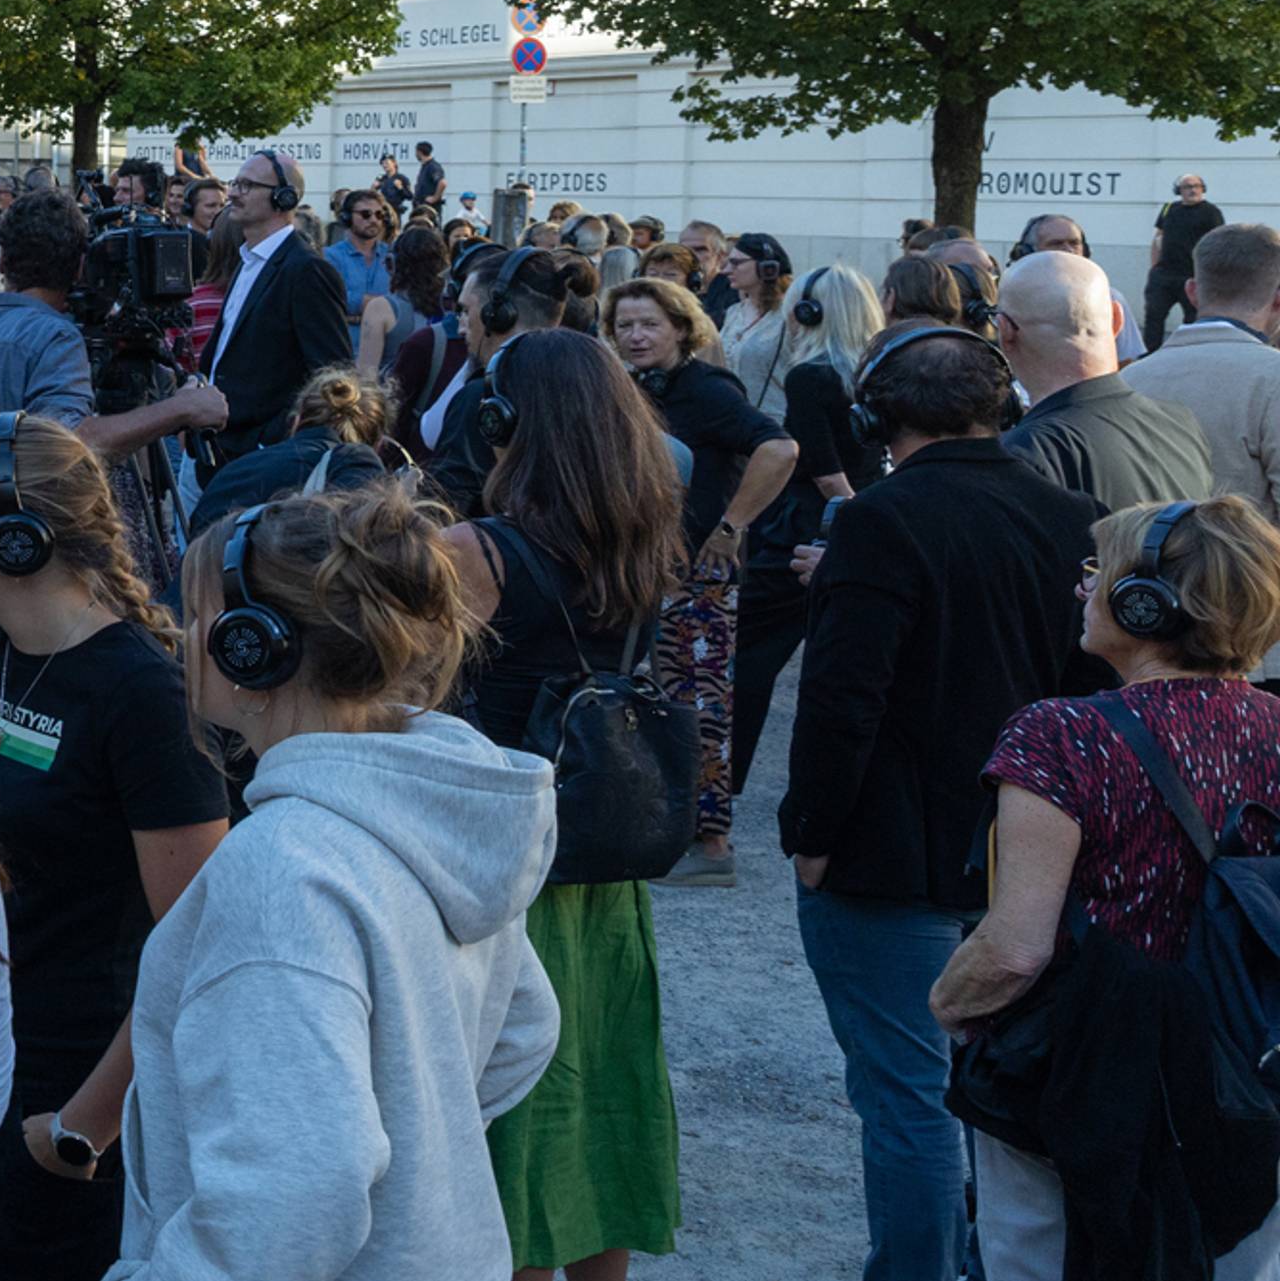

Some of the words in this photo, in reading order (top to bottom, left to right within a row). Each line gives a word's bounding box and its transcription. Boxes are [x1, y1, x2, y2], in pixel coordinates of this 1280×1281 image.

[419, 23, 502, 48] SCHLEGEL
[388, 111, 418, 129] VON
[206, 143, 256, 161] PHRAIM
[342, 138, 410, 160] HORVÁTH
